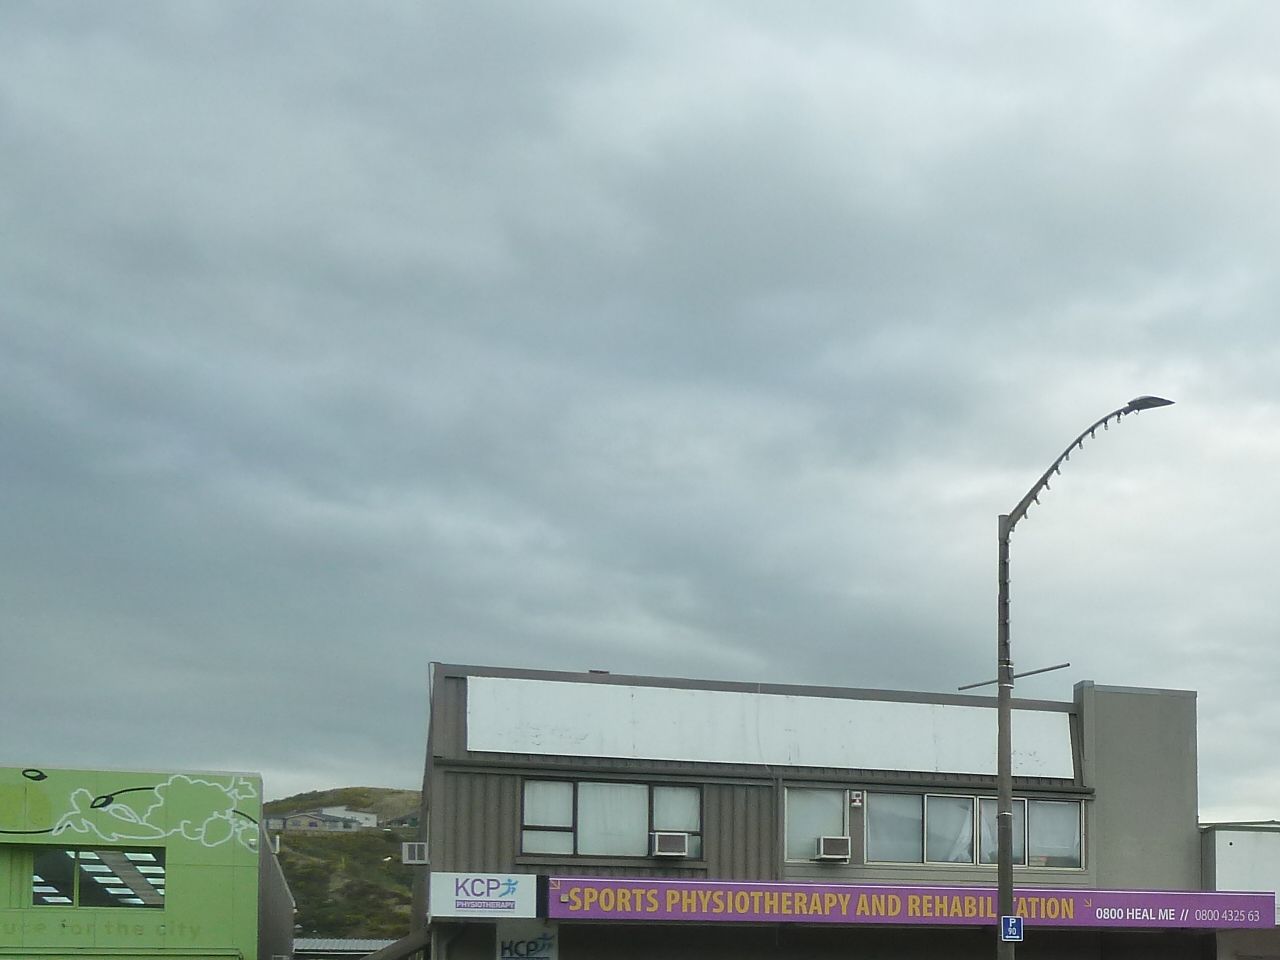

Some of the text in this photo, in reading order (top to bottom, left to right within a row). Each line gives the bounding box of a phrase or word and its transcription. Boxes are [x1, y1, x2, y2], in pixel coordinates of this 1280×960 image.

[455, 878, 500, 897] KCP
[455, 900, 516, 909] PHYSIOTHERAPY
[569, 887, 1074, 919] SPORTS PHYSIOTHERAPY AND REHABILATION
[1009, 918, 1016, 927] P
[1096, 907, 1124, 920] 0800
[1126, 908, 1155, 920] HEAL
[1158, 908, 1176, 921] ME
[1195, 909, 1219, 921] 0800
[1221, 909, 1246, 922] 4325
[1247, 910, 1260, 922] 63
[105, 919, 145, 935] the
[155, 919, 200, 940] city
[1008, 927, 1017, 935] 90
[501, 940, 538, 957] KCP
